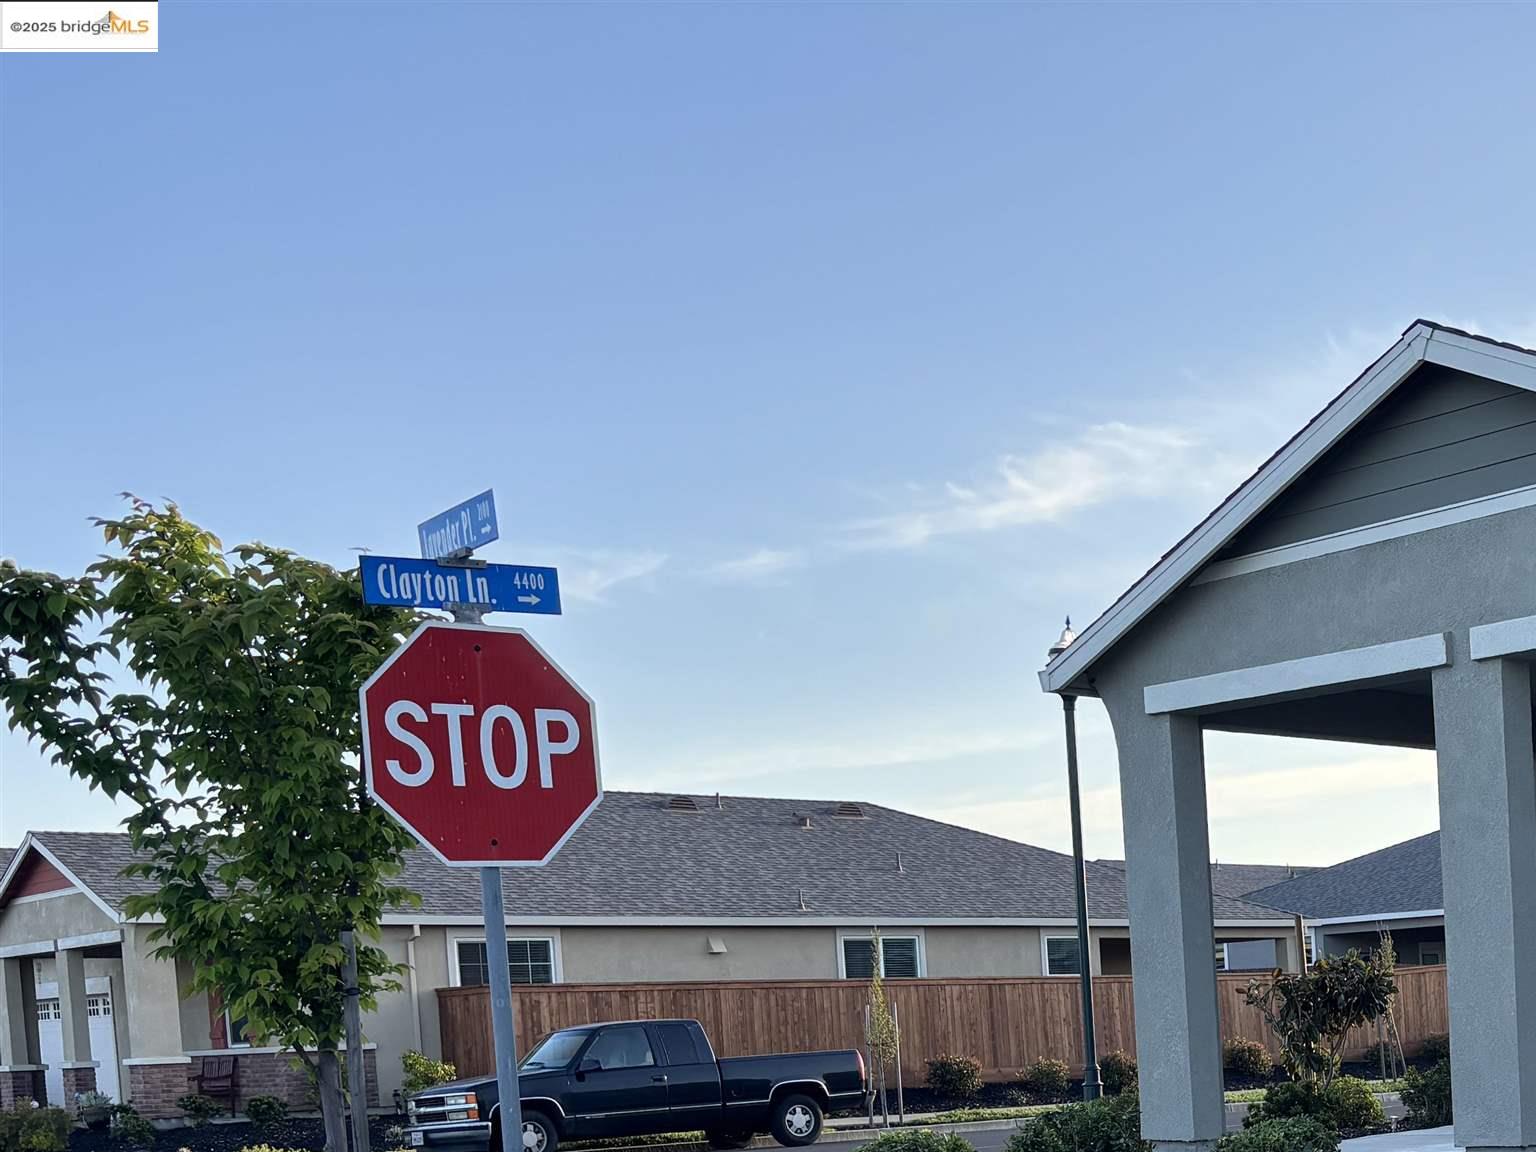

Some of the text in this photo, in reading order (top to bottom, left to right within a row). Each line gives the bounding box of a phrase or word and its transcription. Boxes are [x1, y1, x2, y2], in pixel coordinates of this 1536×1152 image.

[461, 507, 477, 546] Pl.
[377, 563, 497, 605] Clayton Ln.
[513, 571, 545, 591] 4400
[384, 699, 580, 790] STOP
